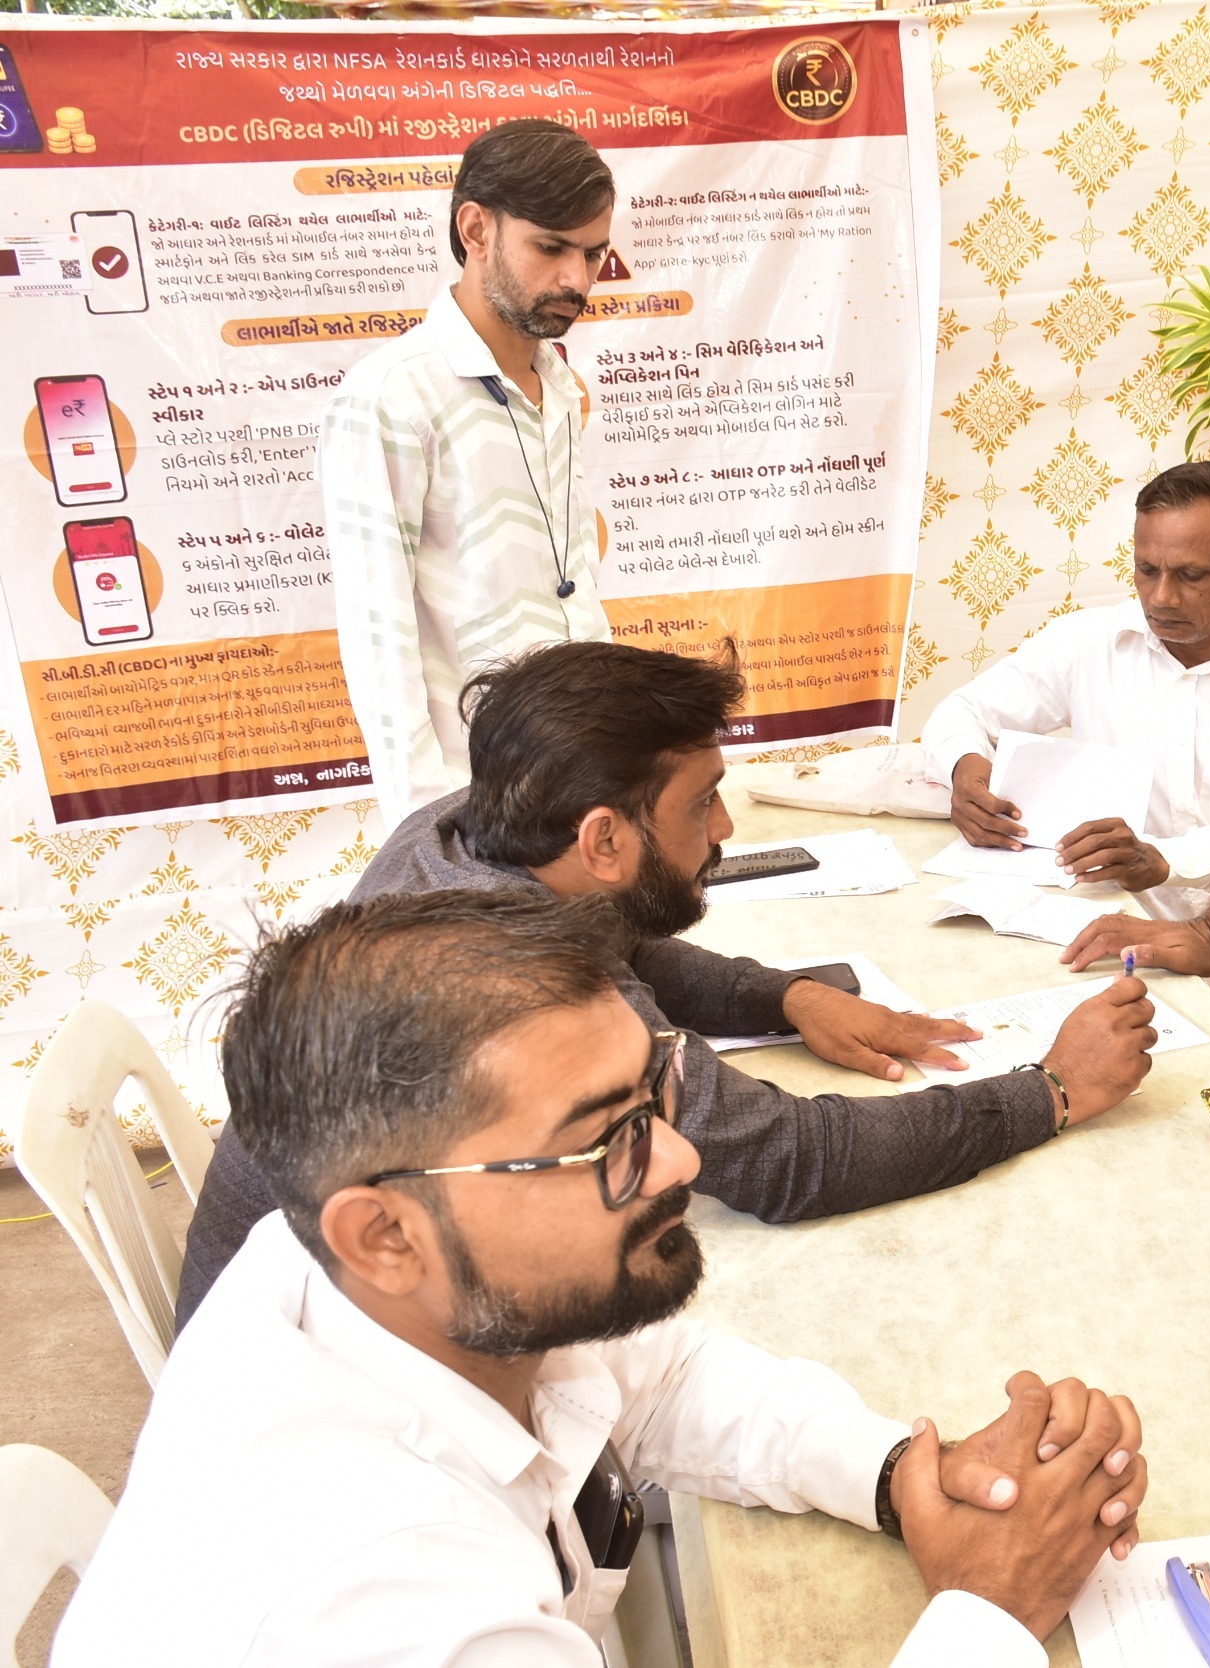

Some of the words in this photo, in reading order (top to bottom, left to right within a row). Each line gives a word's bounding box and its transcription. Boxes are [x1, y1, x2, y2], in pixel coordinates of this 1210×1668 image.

[175, 51, 223, 69] રાજ્ય
[229, 51, 287, 69] સરકાર
[292, 52, 327, 71] દ્વારા
[333, 52, 387, 69] NFSA
[395, 46, 466, 69] રેશનકાર્ડ
[471, 47, 531, 68] ધારકોને
[536, 45, 614, 68] સરળતાથી
[619, 45, 674, 67] રેશનનો
[278, 80, 326, 103] જથ્થો
[331, 80, 396, 101] મેળવવા
[401, 79, 454, 99] અંગેની
[459, 79, 525, 99] ડિજિટલ
[529, 78, 592, 98] પદ્ધતિ....
[786, 88, 844, 108] CBDC
[179, 124, 239, 143] CBDC
[242, 117, 323, 144] (ડિજિટલ
[327, 115, 373, 140] રુપી)
[377, 114, 399, 137] માં
[403, 111, 492, 140] રજીસ્ટ્રેશન
[601, 104, 691, 129] માર્ગદર્શિકા
[325, 166, 404, 191] રજિસ્ટ્રેશન
[409, 165, 457, 187] પહેલાં
[630, 194, 677, 210] કેટેગરી-૨:
[679, 192, 706, 205] વાઈટ
[707, 188, 747, 204] લિસ્ટિંગ
[748, 192, 756, 201] ન
[758, 187, 785, 201] થયેલ
[788, 184, 841, 199] લાભાર્થીઓ
[843, 183, 869, 196] માટે:-
[148, 217, 204, 232] કેટેગરી-૧:
[209, 216, 241, 230] વાઈટ
[247, 212, 292, 229] લિસ્ટિંગ
[298, 211, 329, 226] થયેલ
[335, 208, 397, 224] લાભાર્થીઓ
[403, 207, 432, 221] માટે:-
[154, 253, 203, 270] સ્માર્ટફોન
[208, 251, 229, 266] અને
[234, 250, 256, 265] લિંક
[262, 250, 286, 264] કરેલ
[291, 251, 314, 262] SIM
[320, 246, 339, 261] કાર્ડ
[344, 245, 367, 260] સાથે
[371, 243, 411, 258] જનસેવા
[416, 242, 437, 256] કેન્દ્ર
[157, 275, 192, 286] અથવા
[194, 273, 224, 285] V.C.E
[226, 272, 260, 283] અથવા
[262, 269, 312, 282] Banking
[314, 265, 414, 279] Correspondence
[416, 259, 438, 273] પાસે
[601, 297, 631, 316] સ્ટેપ
[237, 318, 319, 341] લાભાર્થીએ
[322, 316, 354, 336] જાતે
[596, 348, 624, 366] સ્ટેપ
[639, 345, 665, 362] અને
[695, 342, 723, 359] સિમ
[726, 337, 796, 357] વેરિફિકેશન
[800, 334, 824, 350] અને
[598, 366, 671, 385] એપ્લિકેશન
[674, 363, 699, 385] પિન
[147, 382, 179, 400] સ્ટેપ
[196, 378, 225, 396] અને
[257, 374, 287, 392] એપ
[152, 405, 204, 423] સ્વીકાર
[155, 429, 176, 446] પ્લે
[180, 427, 213, 445] સ્ટોર
[215, 424, 253, 443] પરથી
[255, 425, 293, 440] 'PNB
[161, 449, 226, 470] ડાઉનલોડ
[609, 472, 636, 489] સ્ટેપ
[653, 467, 678, 484] અને
[710, 466, 753, 480] આધાર
[757, 464, 786, 477] OTP
[789, 457, 813, 474] અને
[816, 454, 860, 473] નોંધણી
[862, 450, 885, 473] પૂર્ણ
[165, 473, 209, 492] નિયમો
[212, 470, 239, 488] અને
[242, 467, 280, 486] શરતો
[177, 531, 206, 548] સ્ટેપ
[224, 527, 252, 545] અને
[284, 522, 325, 540] વોલેટ
[610, 618, 654, 637] ગત્યની
[657, 619, 695, 637] સૂચના
[41, 660, 116, 682] સી.બી.ડી.સી
[118, 657, 167, 676] (CBDC)
[169, 656, 183, 667] ના
[184, 651, 214, 670] મુખ્ય
[216, 643, 279, 664] ફાયદાઓ:-
[274, 772, 309, 786] અન્ન,
